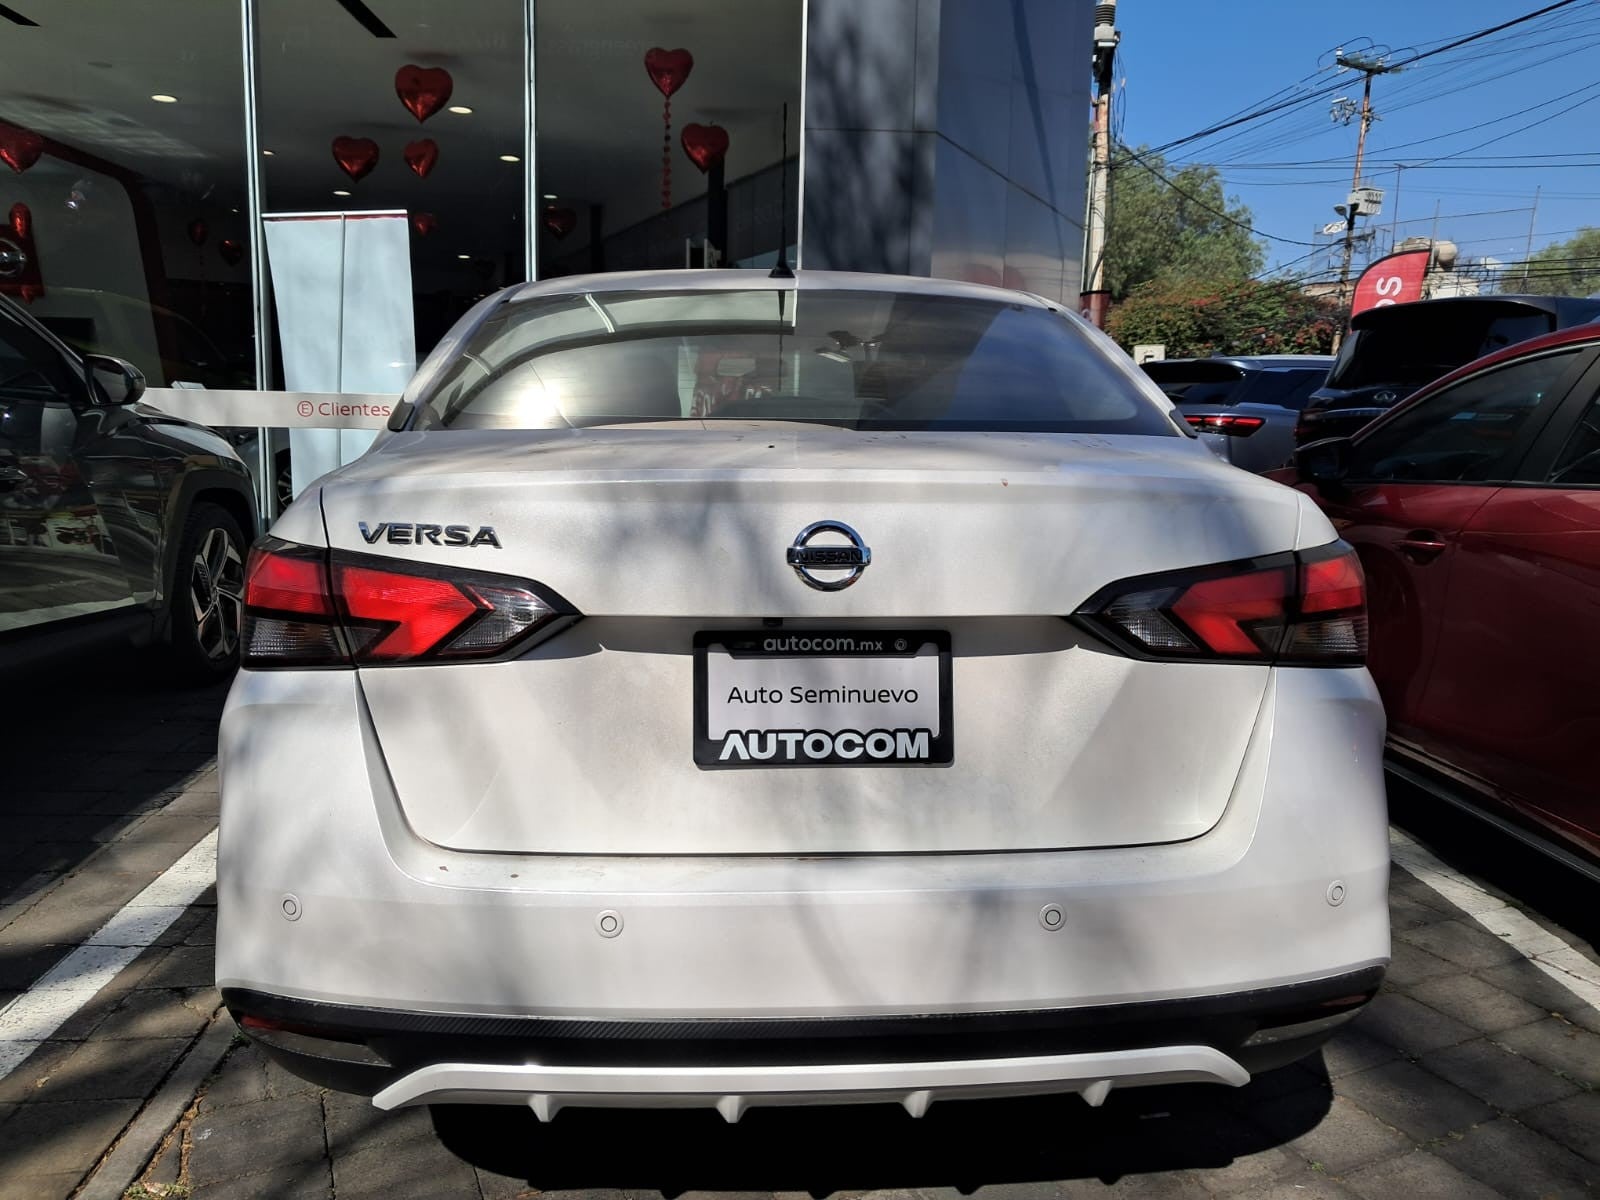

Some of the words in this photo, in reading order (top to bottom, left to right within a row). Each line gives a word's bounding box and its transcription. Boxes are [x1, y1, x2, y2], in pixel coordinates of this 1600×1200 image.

[318, 402, 391, 417] Clientes
[358, 521, 503, 549] VERSA
[796, 550, 861, 563] NISSAN
[763, 636, 883, 651] autocom.mx
[727, 686, 783, 704] Auto
[790, 685, 919, 704] Seminuevo
[719, 732, 929, 760] AUTOCOM
